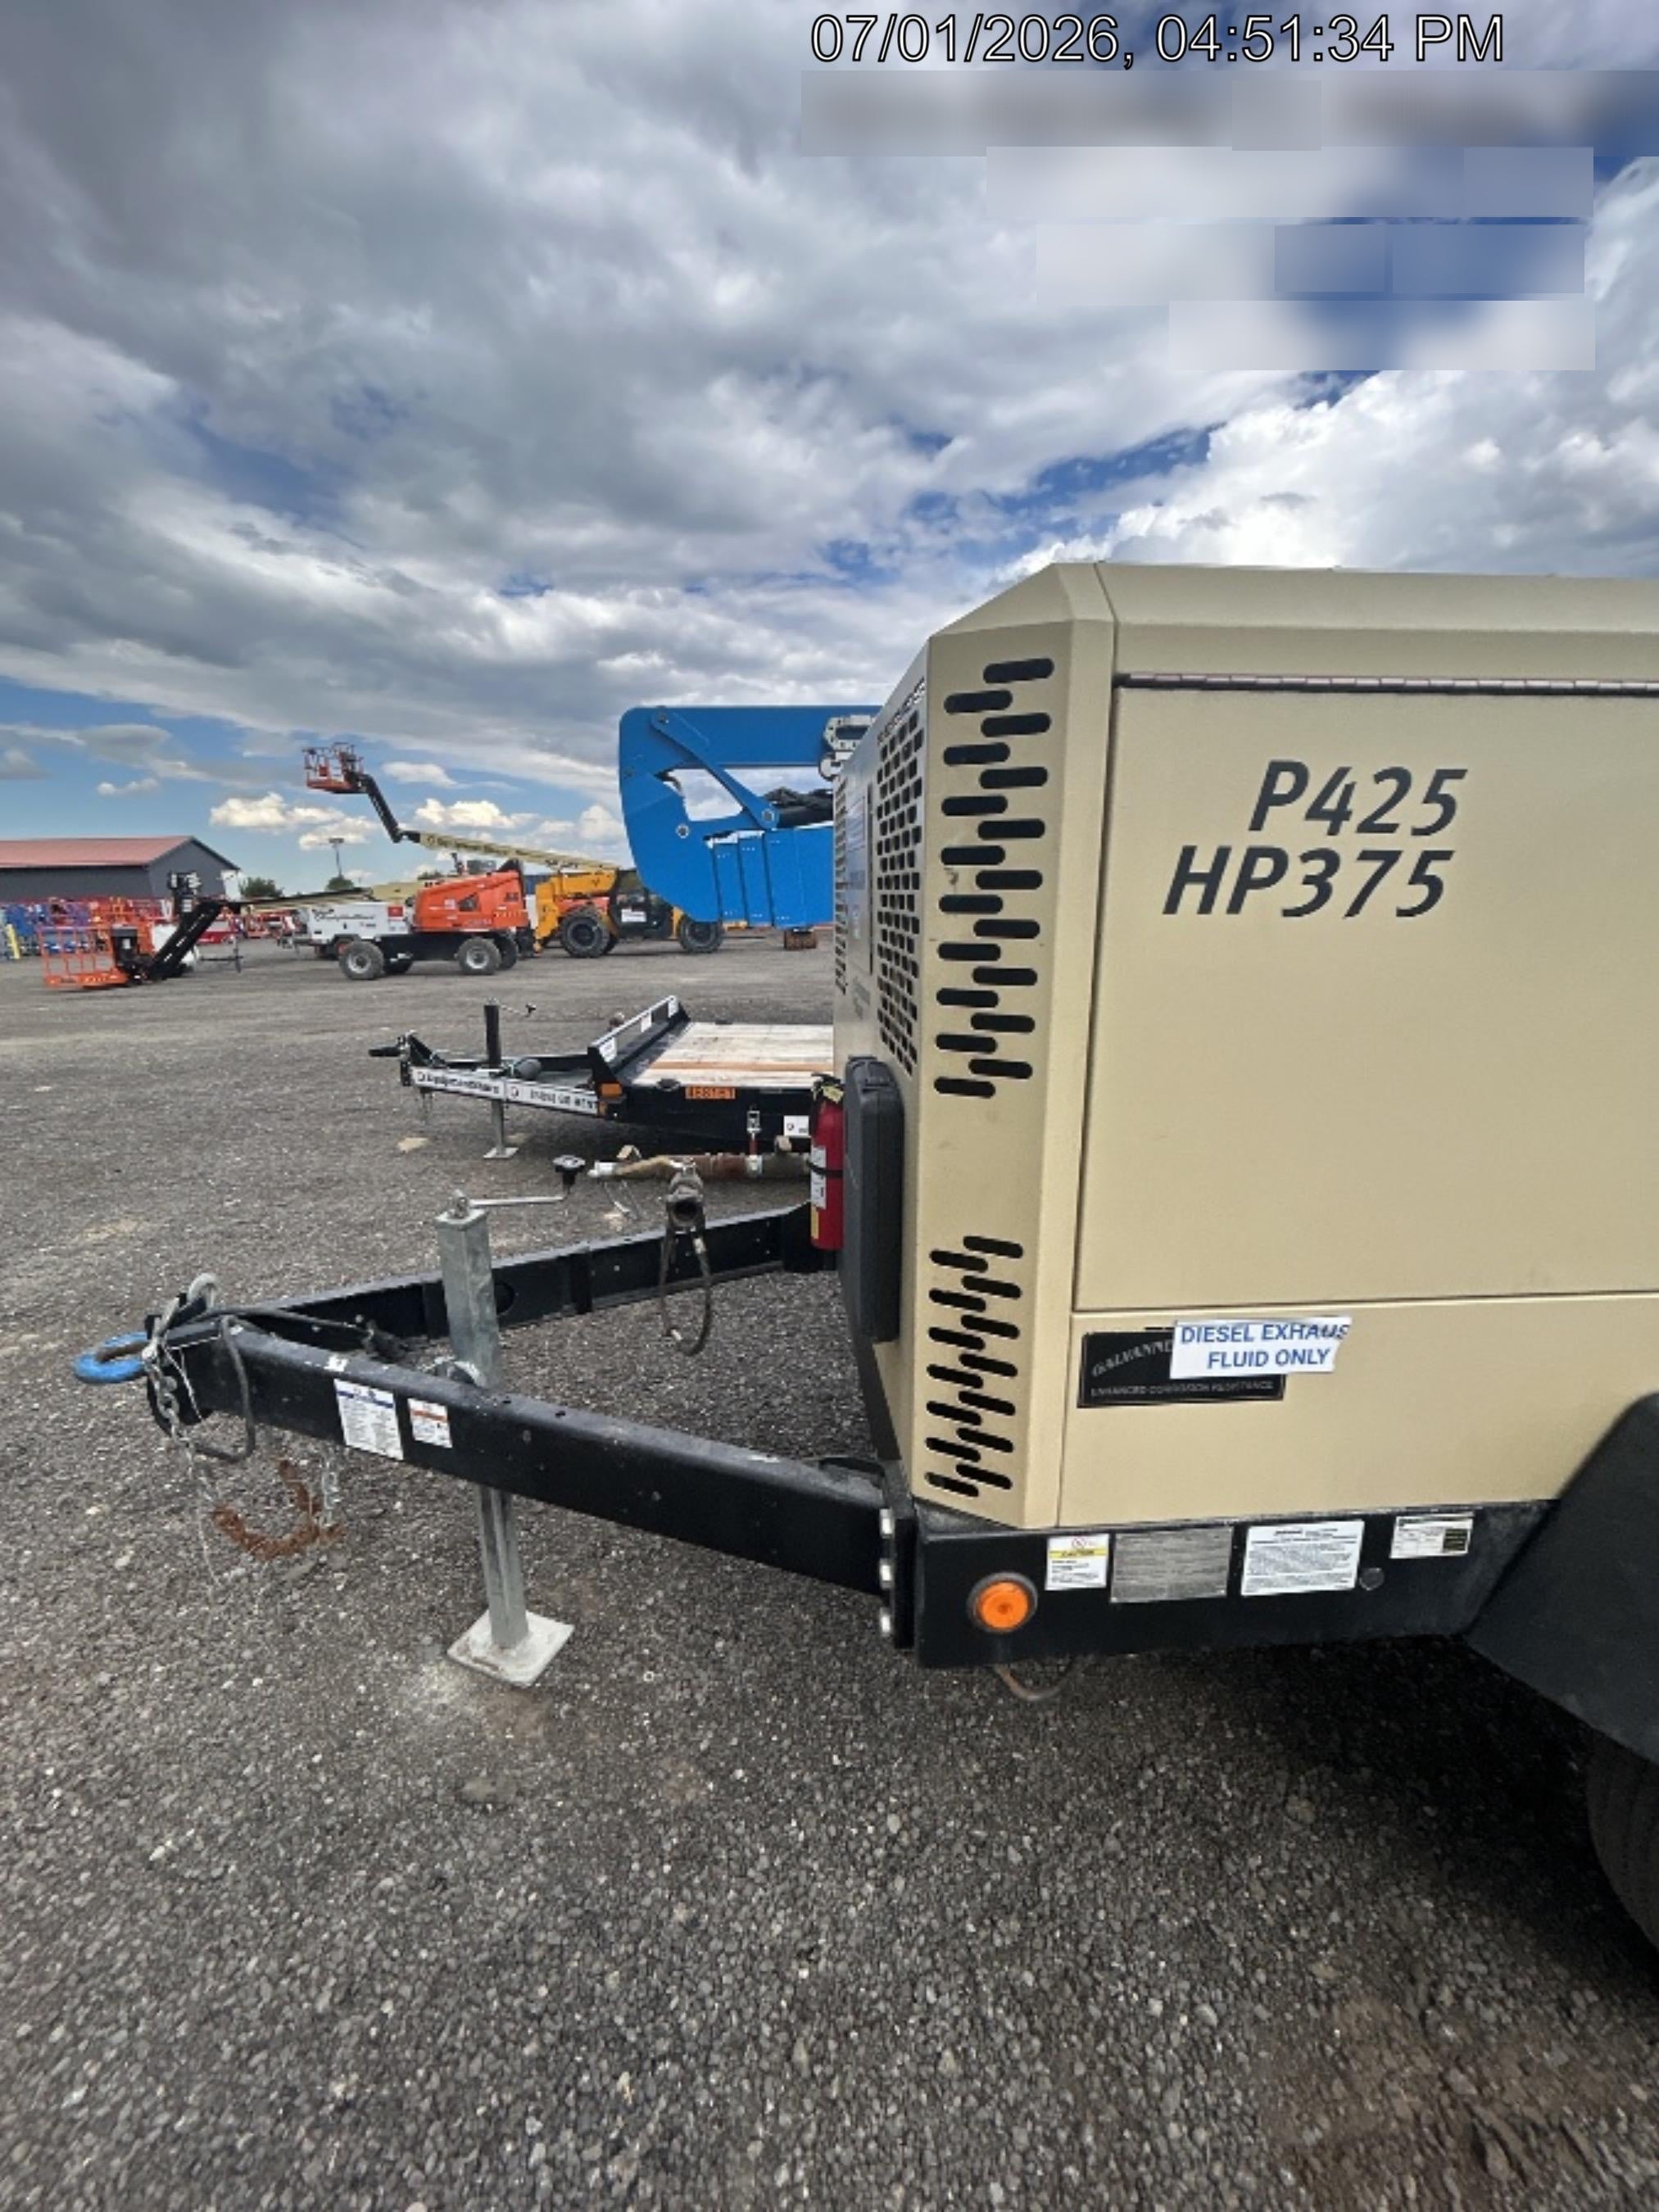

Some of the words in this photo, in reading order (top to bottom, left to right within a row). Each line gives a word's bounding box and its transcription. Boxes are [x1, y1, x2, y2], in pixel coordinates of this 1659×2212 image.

[1248, 759, 1468, 836] P425
[1162, 845, 1456, 919] HP375
[1181, 1323, 1254, 1344] DIESEL
[1207, 1350, 1270, 1369] FLUID
[1275, 1349, 1331, 1367] ONLY
